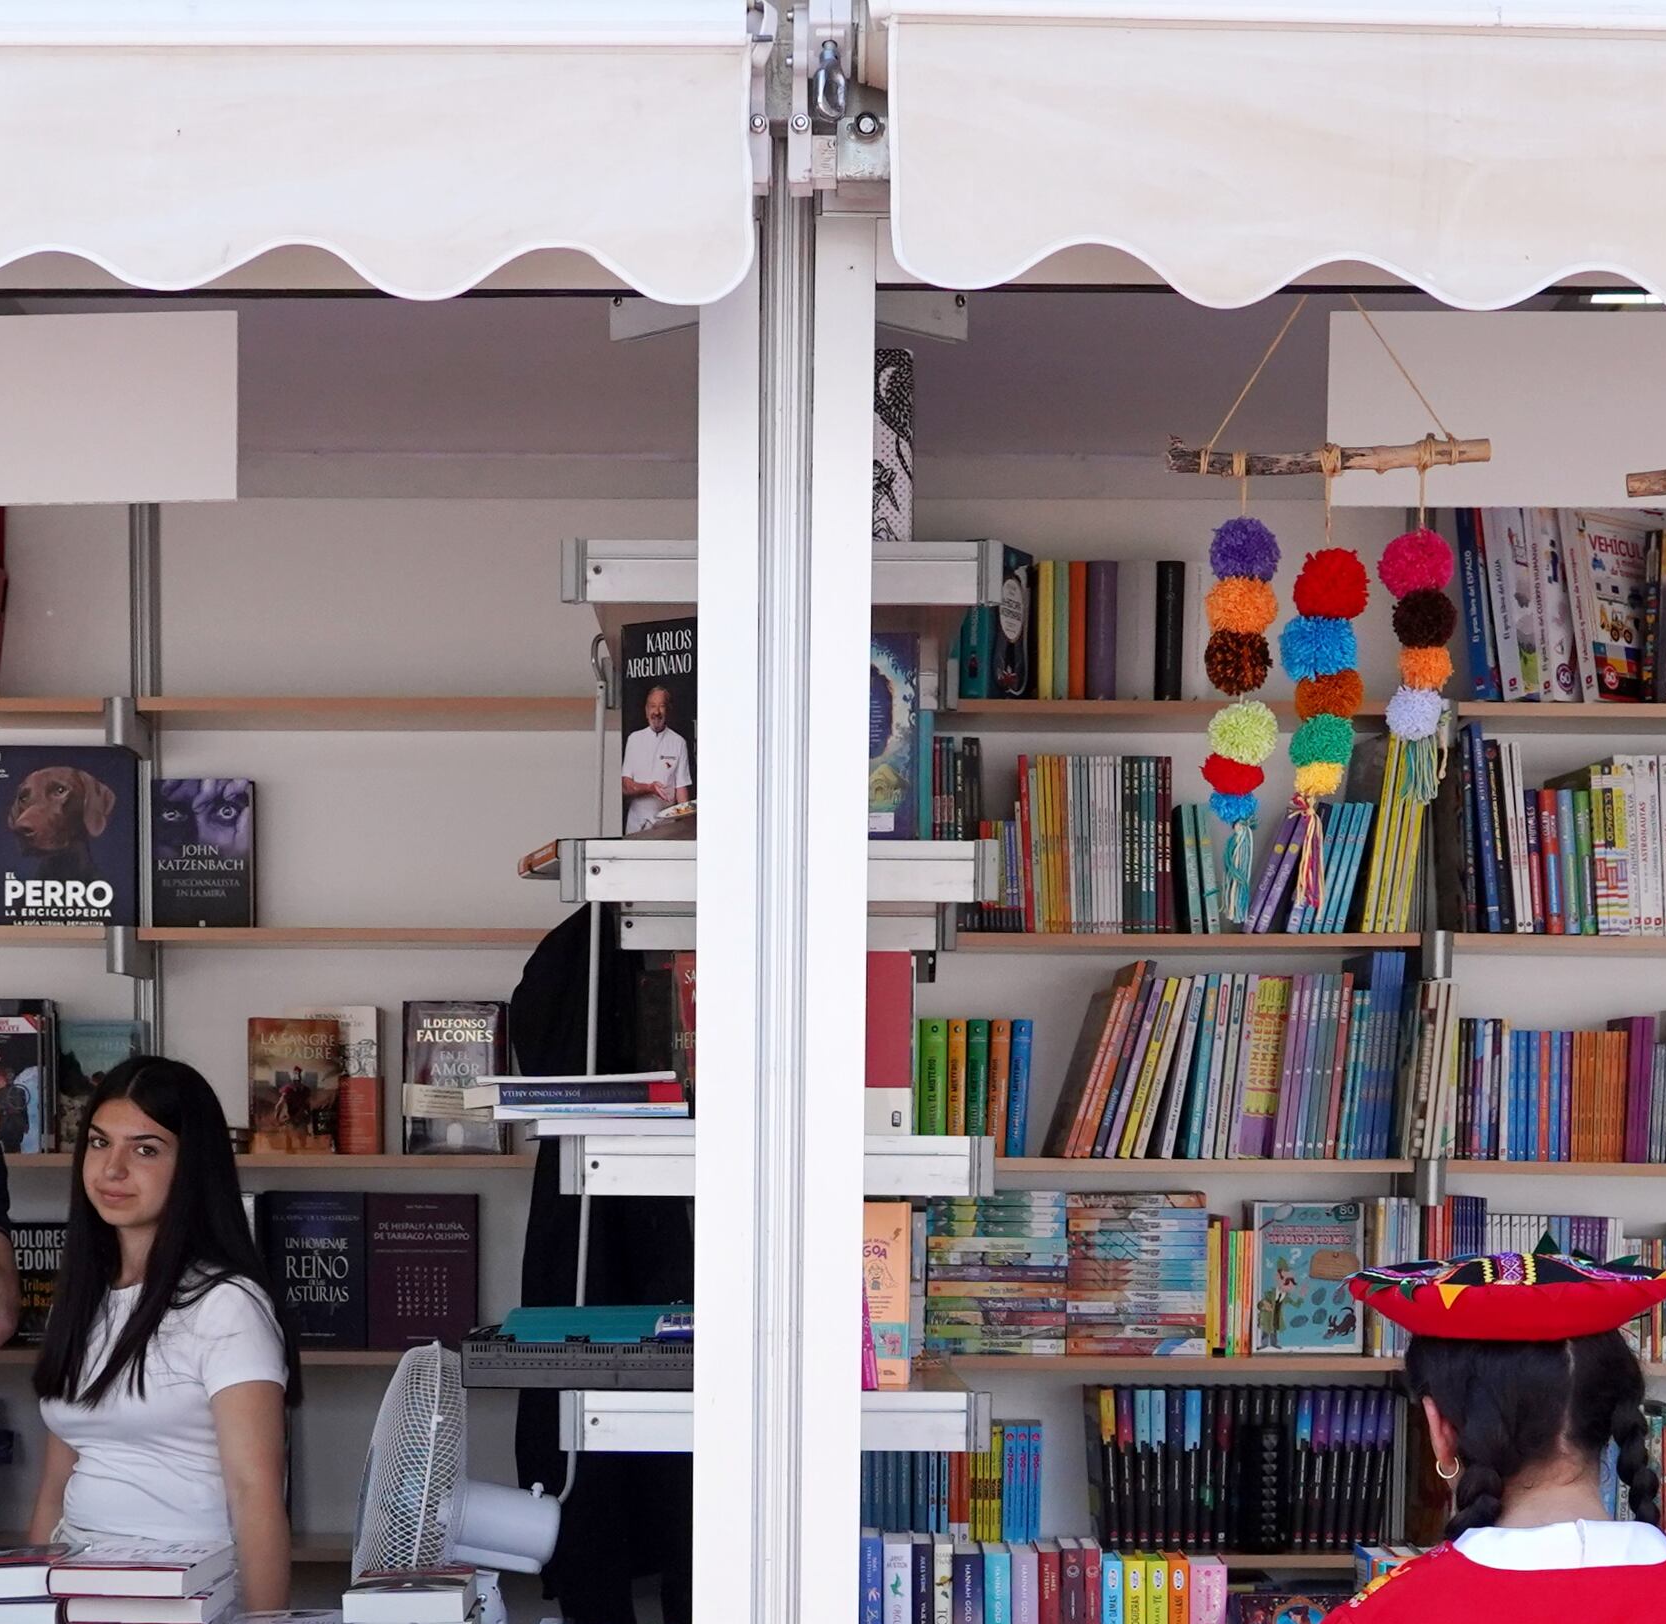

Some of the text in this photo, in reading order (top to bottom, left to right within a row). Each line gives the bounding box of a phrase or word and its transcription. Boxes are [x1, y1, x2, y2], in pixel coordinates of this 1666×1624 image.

[1464, 550, 1473, 584] ESPACIO
[1494, 559, 1504, 582] AGUA
[1535, 582, 1543, 615] CUERPO
[646, 629, 692, 654] KARLOS
[626, 652, 692, 680] ARGUIÑANO
[1638, 801, 1648, 863] ASTRONAUTAS
[182, 844, 219, 858] JOHN
[158, 859, 244, 872] KATZENBACH
[5, 872, 16, 880] EL
[4, 880, 114, 909] PERRO
[21, 907, 113, 918] ENCICLOPEDIA
[423, 1018, 487, 1029] ILDEFONSO
[260, 1033, 336, 1047] LA SANGRE
[416, 1029, 494, 1043] FALCONES
[286, 1047, 333, 1060] PADRE
[439, 1050, 470, 1061] EN EL
[1249, 1020, 1262, 1086] ANIMALES
[1258, 1020, 1272, 1086] ANIMALES
[430, 1062, 480, 1076] AMOR
[502, 1089, 528, 1098] ABELLA
[529, 1090, 562, 1098] ANTONIO
[11, 1229, 67, 1248] DOLORES
[285, 1237, 349, 1252] UN HOMENAJE
[15, 1249, 63, 1270] EDON
[285, 1255, 349, 1279] REINO
[285, 1286, 350, 1302] ASTURIAS
[919, 1574, 927, 1593] VERNE
[964, 1564, 972, 1622] HANNAH GOLD
[994, 1565, 1002, 1623] HANNAH GOLD
